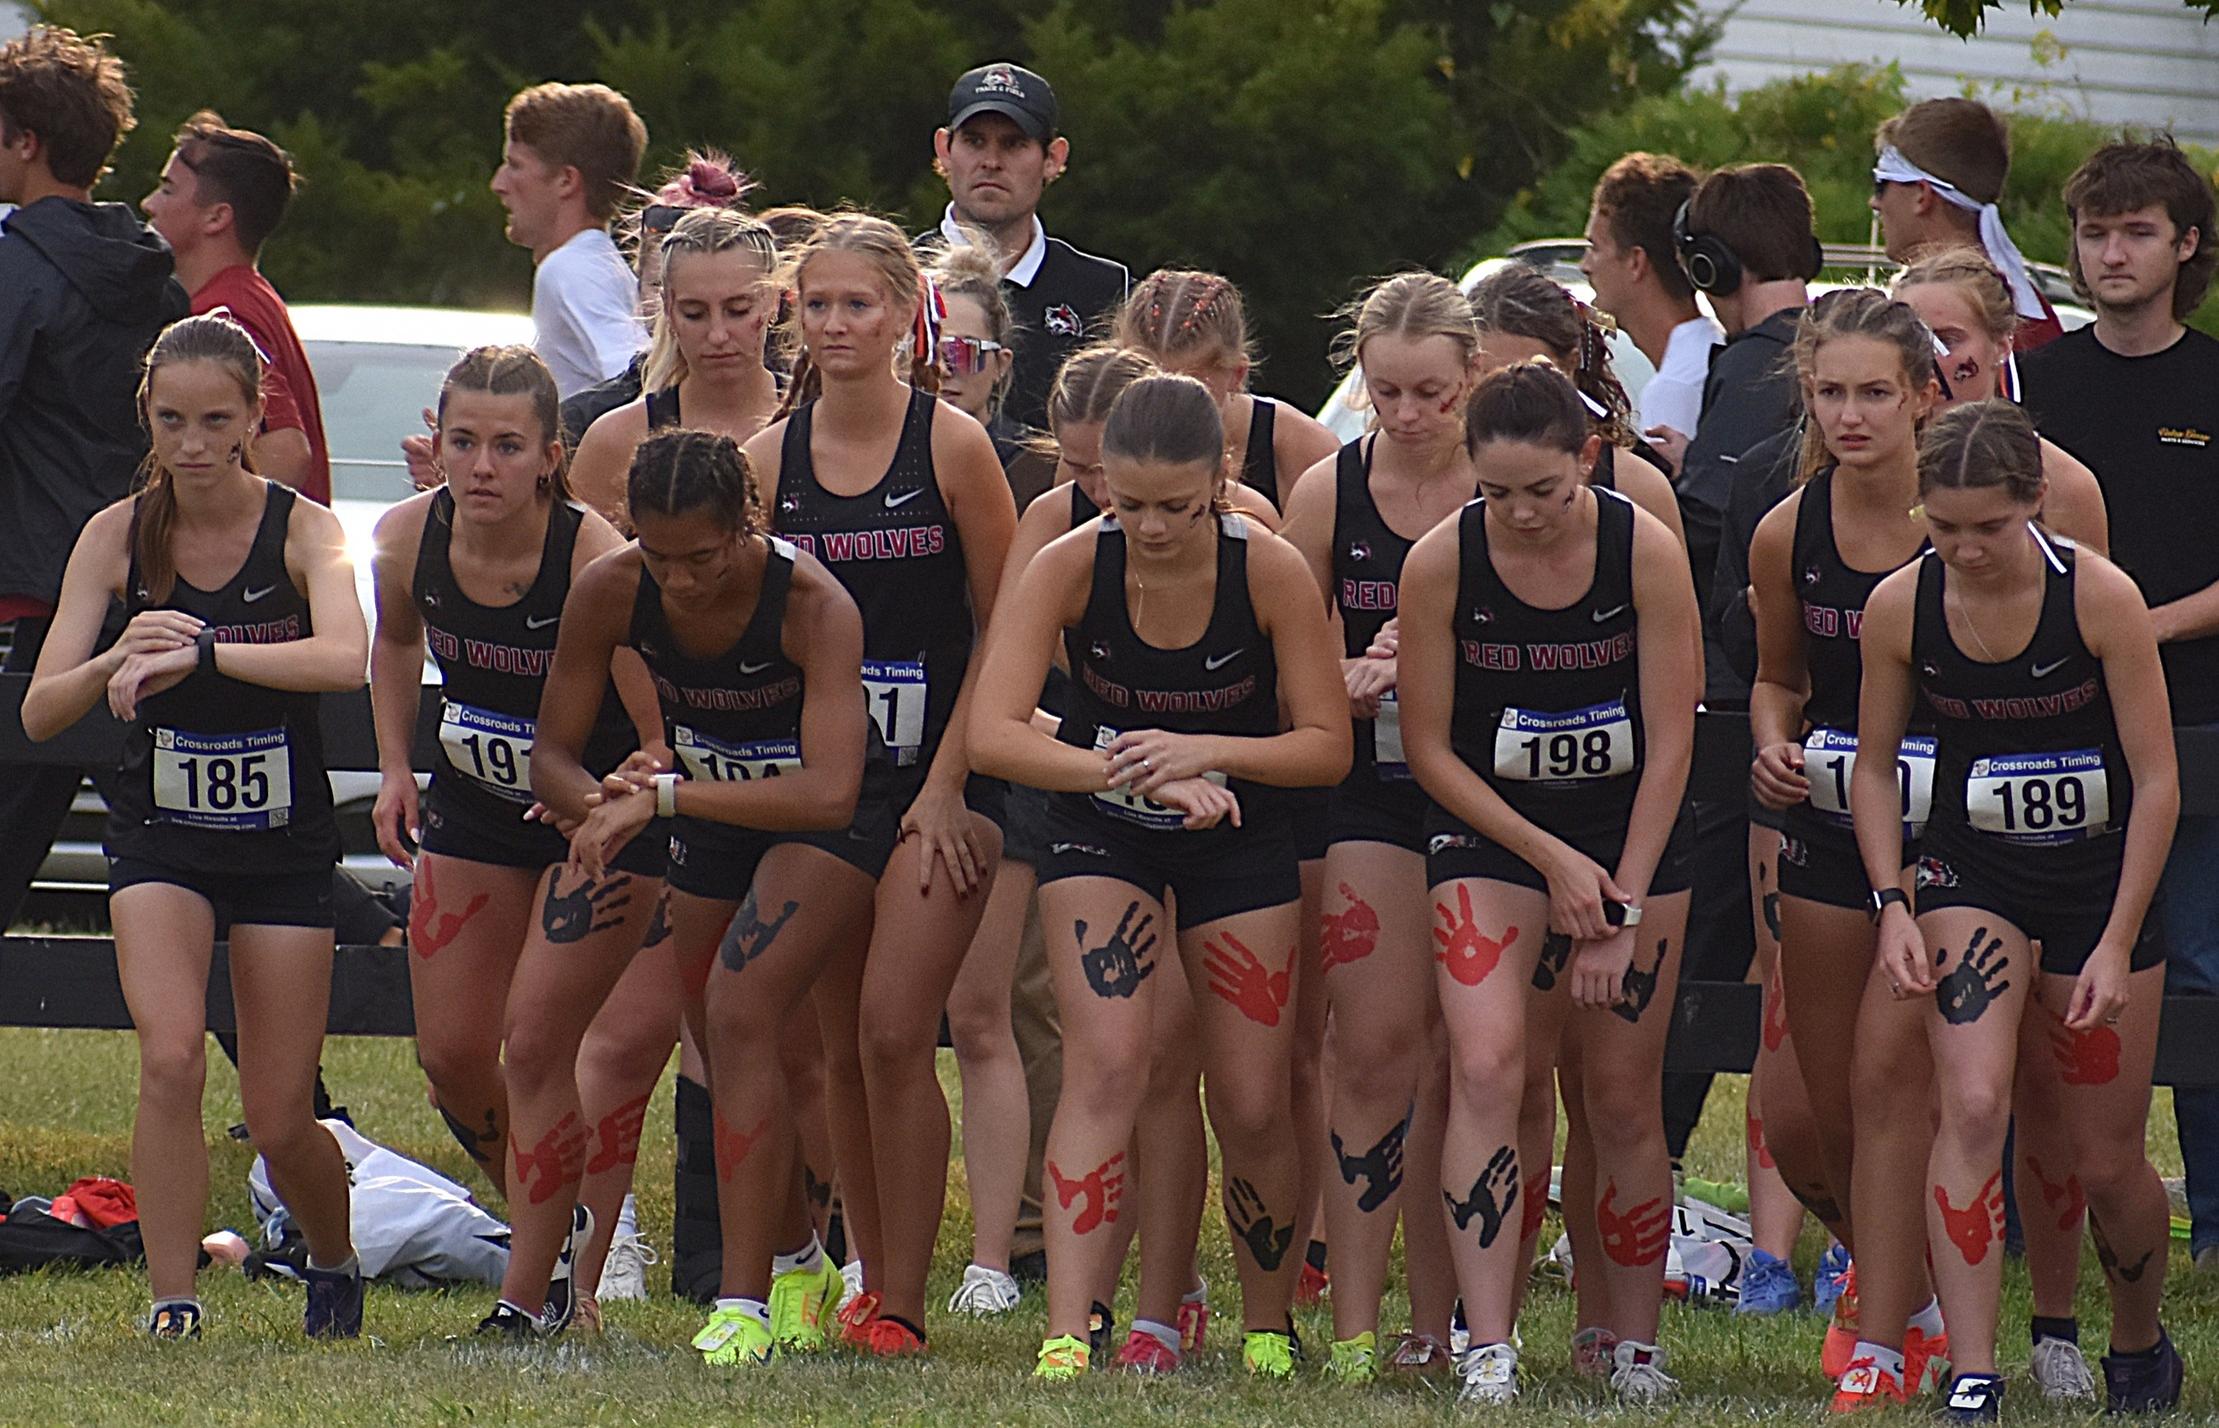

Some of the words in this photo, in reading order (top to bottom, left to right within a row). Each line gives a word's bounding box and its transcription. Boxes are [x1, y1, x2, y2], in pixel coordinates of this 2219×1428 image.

[823, 525, 944, 561] WOLVES
[1342, 578, 1397, 610] RED
[215, 614, 300, 644] OLVES
[430, 626, 459, 661] ED
[1461, 640, 1521, 671] RED
[885, 666, 924, 680] Timing
[681, 676, 801, 710] WOLVES
[1136, 675, 1256, 712] WOLVES
[1972, 680, 2098, 719] WOLVES
[461, 710, 521, 733] Crossroads
[1518, 714, 1587, 729] Crossroads
[1589, 705, 1627, 722] Timing
[175, 736, 244, 751] Crossroads
[246, 733, 286, 748] Timing
[755, 743, 798, 756] Timing
[1521, 729, 1612, 778] 198
[1901, 738, 1935, 755] iming
[461, 733, 535, 786] 19
[1990, 758, 2058, 772] Crossroads
[2060, 754, 2101, 768] Timing
[178, 754, 269, 810] 185
[1992, 776, 2087, 831] 189
